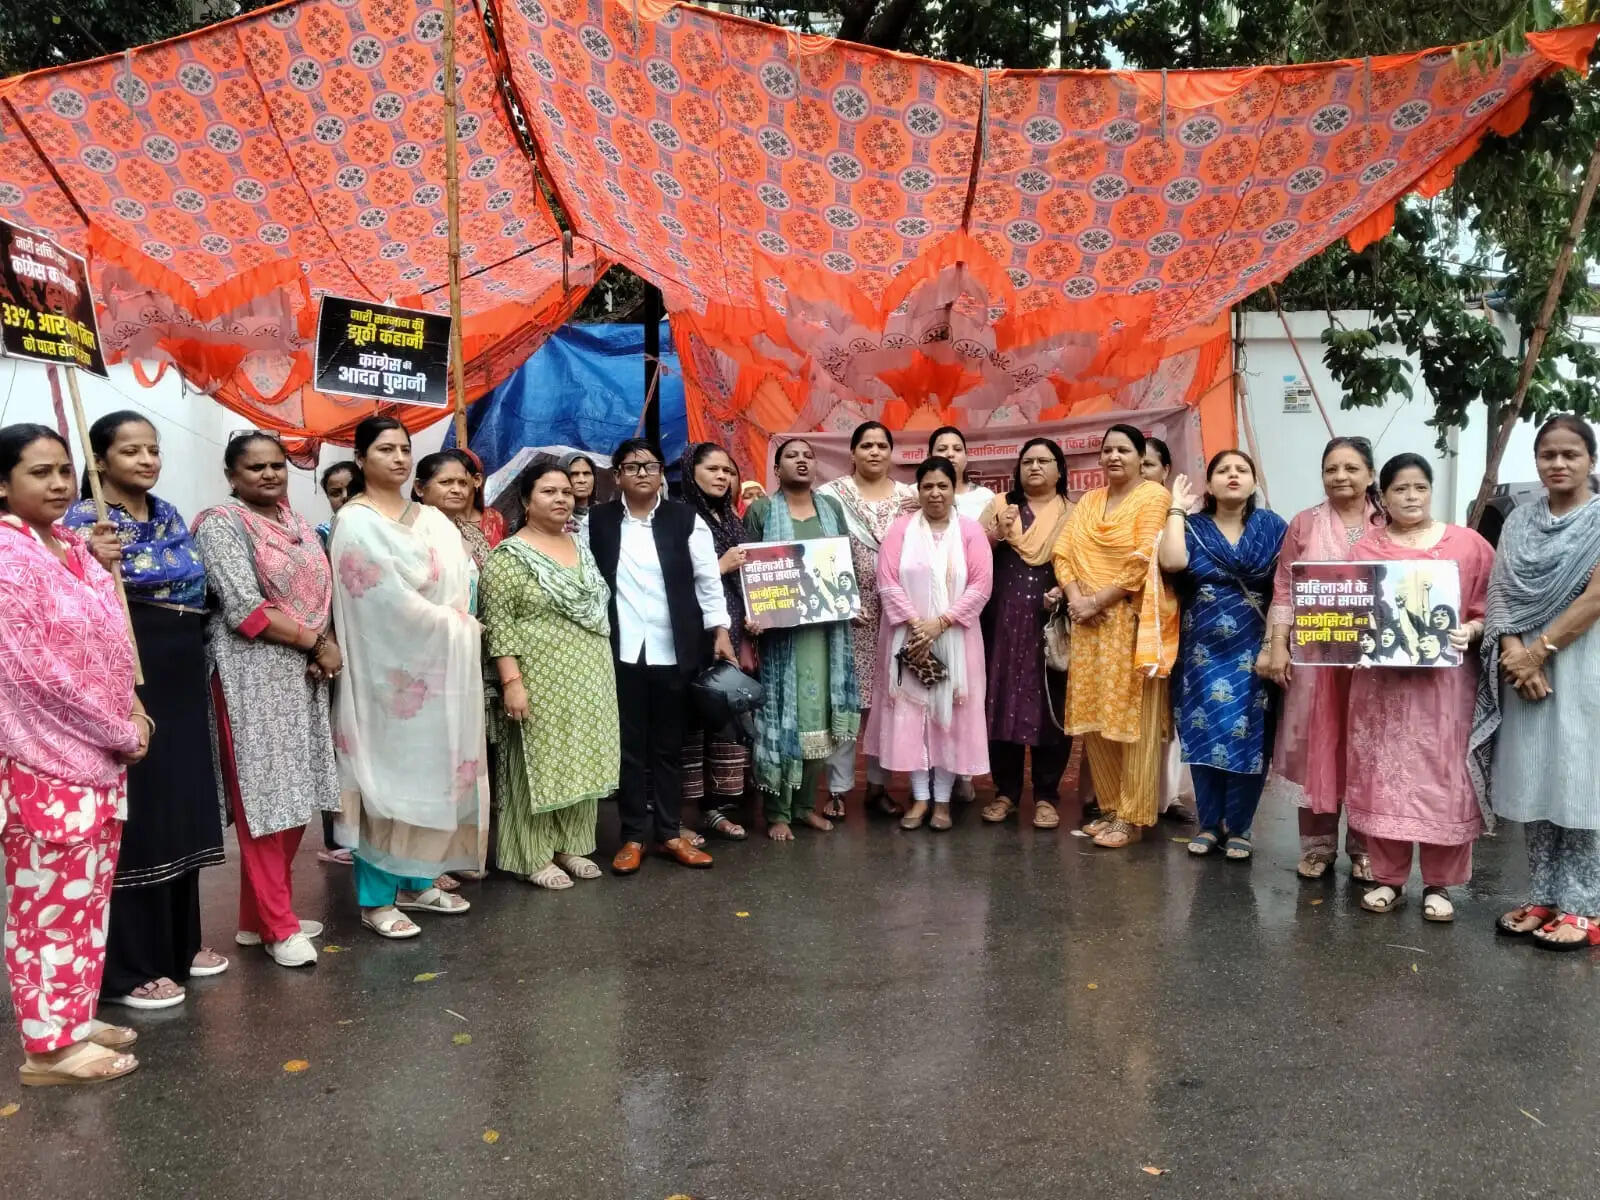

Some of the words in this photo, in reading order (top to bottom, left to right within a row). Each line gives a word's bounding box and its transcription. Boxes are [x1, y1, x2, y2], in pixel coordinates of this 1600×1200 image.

[15, 235, 34, 254] नारी
[10, 254, 47, 281] कांग्रेस
[2, 303, 35, 330] 33%
[350, 309, 373, 323] नारी
[374, 313, 410, 329] सम्मान
[411, 318, 424, 331] की
[22, 333, 36, 352] को
[36, 338, 57, 356] पास
[347, 323, 377, 346] झूठी
[379, 328, 424, 349] कहानी
[358, 351, 402, 372] कांग्रेस
[338, 366, 380, 387] आदत
[382, 372, 427, 395] पुरानी
[902, 447, 925, 461] नारी
[967, 443, 1018, 457] स्वाभिमान
[1065, 436, 1085, 449] फिर
[744, 558, 784, 572] महिलाओं
[784, 557, 794, 568] के
[745, 573, 761, 584] हक
[761, 571, 774, 582] पर
[775, 569, 800, 581] सवाल
[1295, 579, 1353, 594] महिलाओं
[1354, 580, 1368, 594] के
[752, 598, 777, 616] पुरानी
[1295, 594, 1317, 607] हक
[1318, 594, 1336, 607] पर
[1336, 594, 1375, 607] सवाल
[1295, 611, 1354, 628] कांग्रेसियों
[1295, 628, 1331, 646] पुरानी
[1331, 630, 1359, 642] चाल
